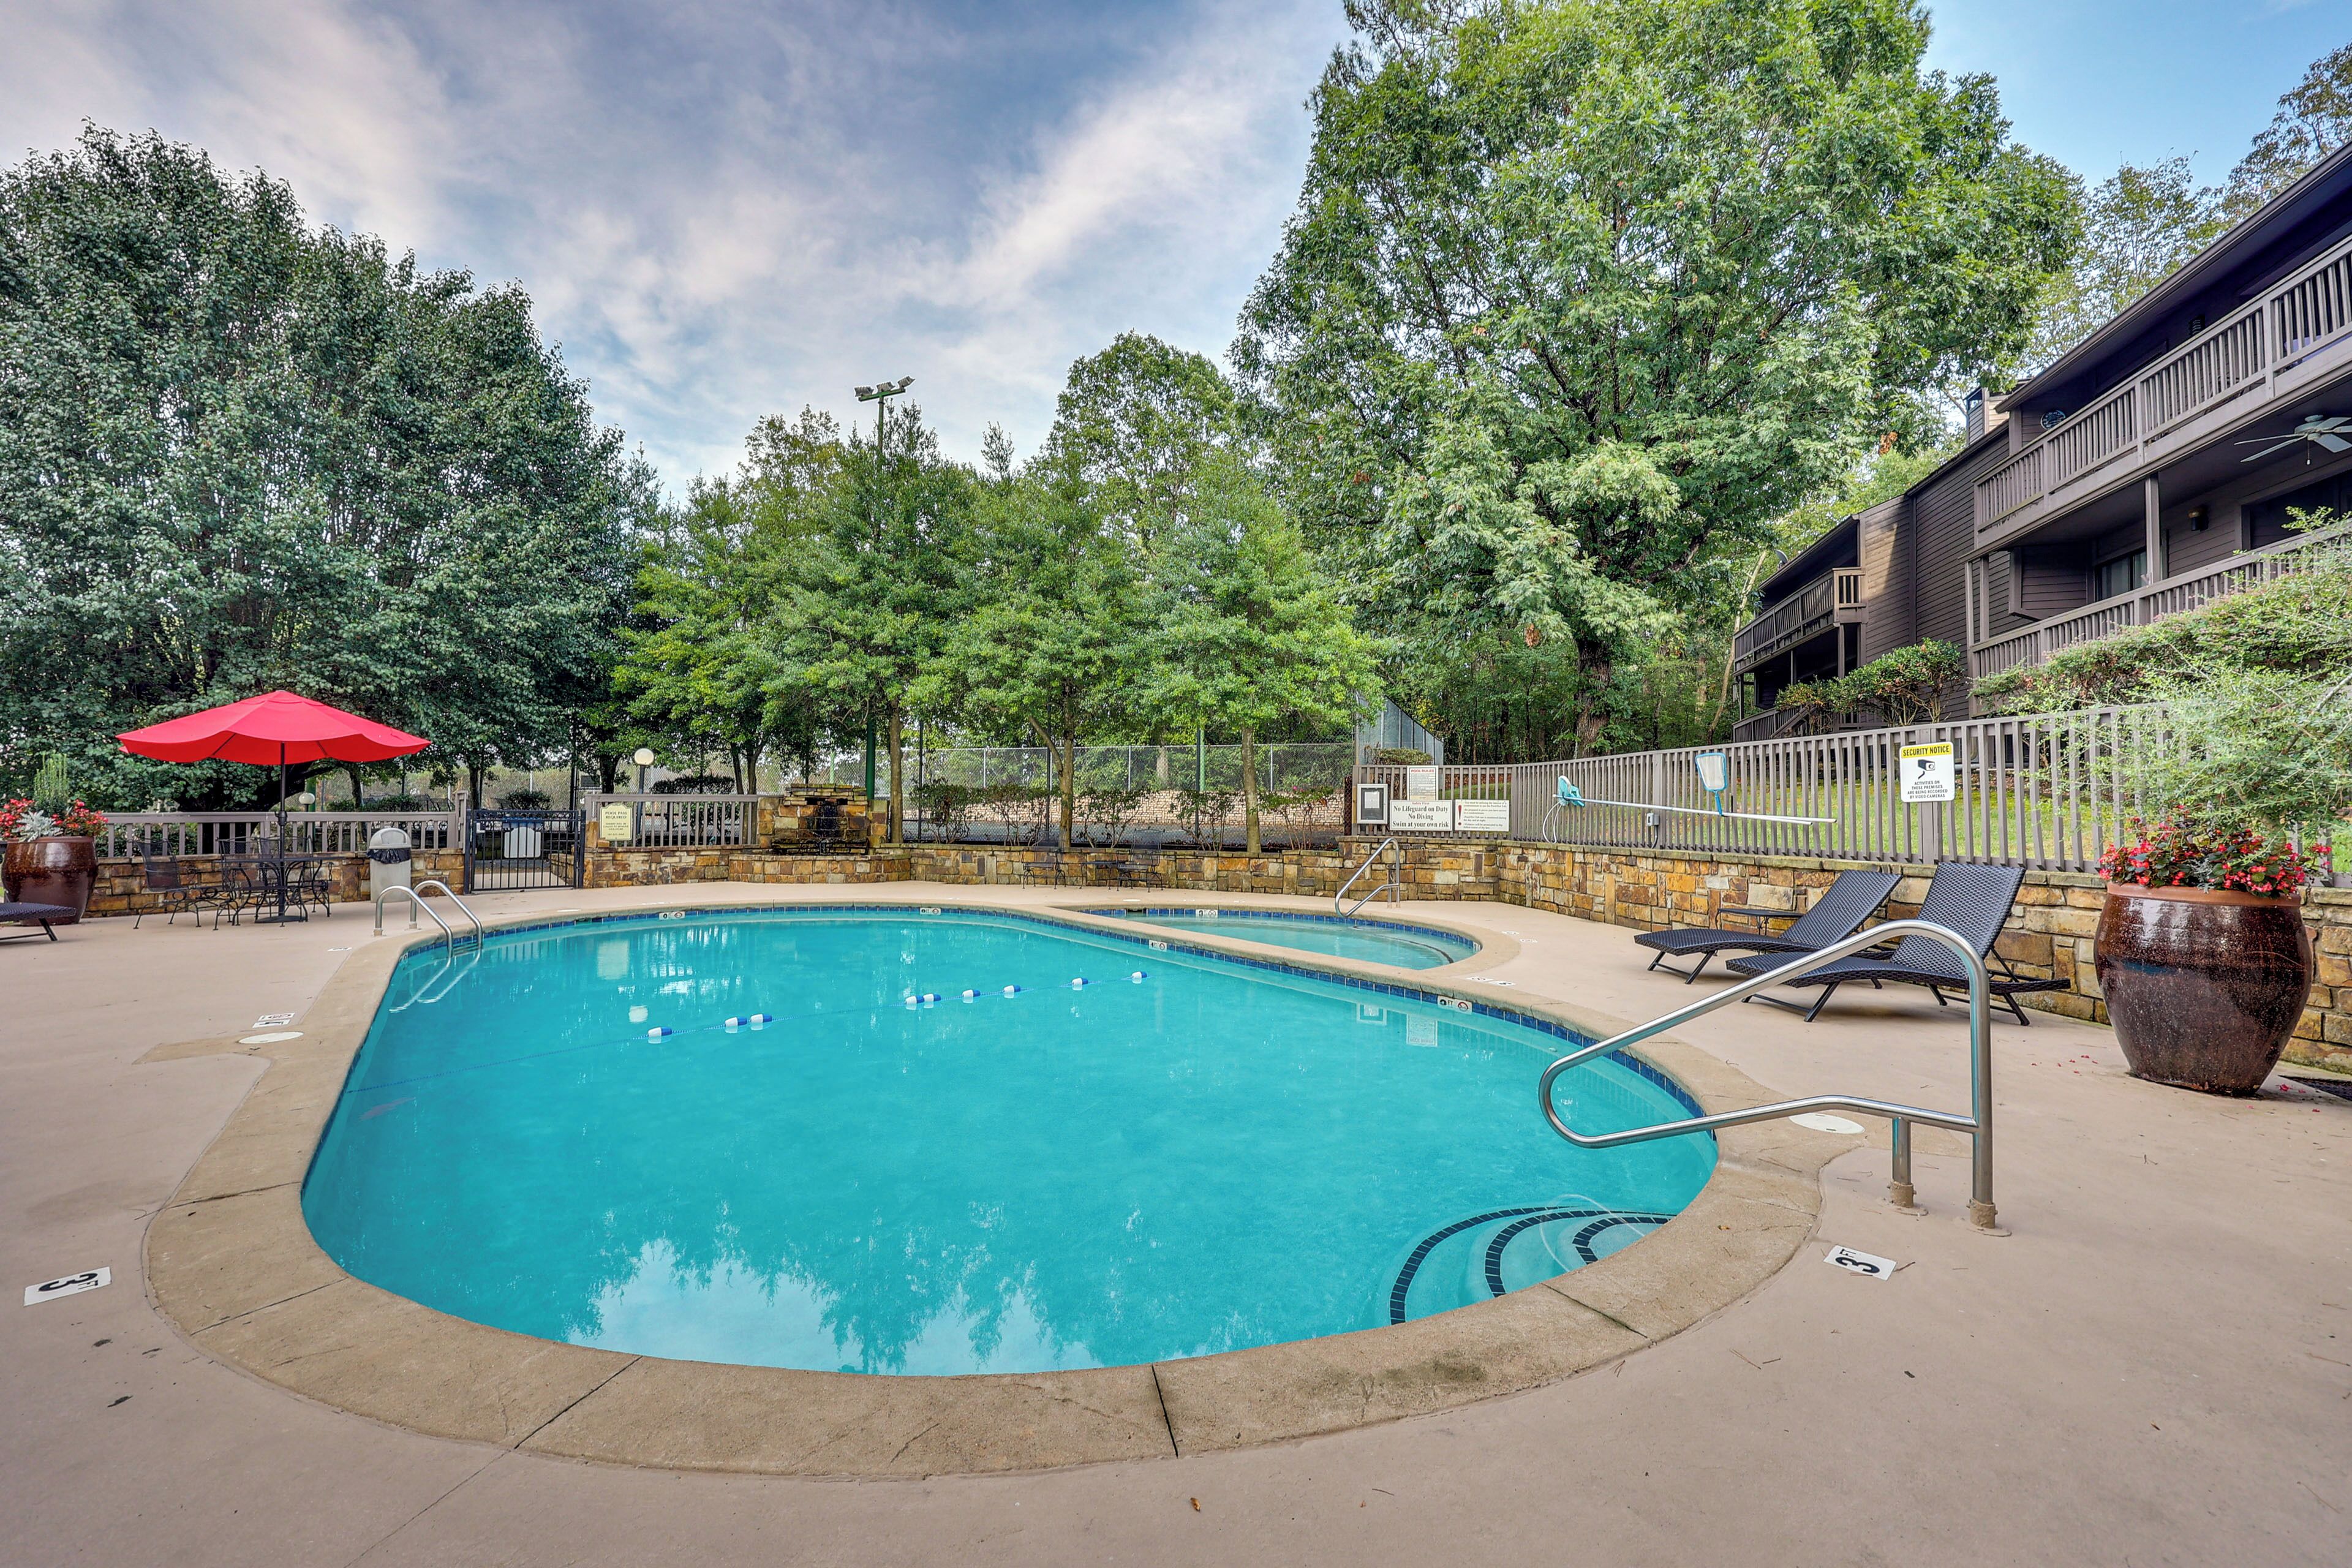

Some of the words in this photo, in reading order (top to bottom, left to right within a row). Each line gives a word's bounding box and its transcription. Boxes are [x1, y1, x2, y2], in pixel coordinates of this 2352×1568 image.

[1903, 748, 1928, 756] SECURITY
[1930, 745, 1950, 754] NOTICE
[1839, 1249, 1856, 1258] FT
[1835, 1257, 1880, 1273] 3
[38, 1273, 98, 1292] 3
